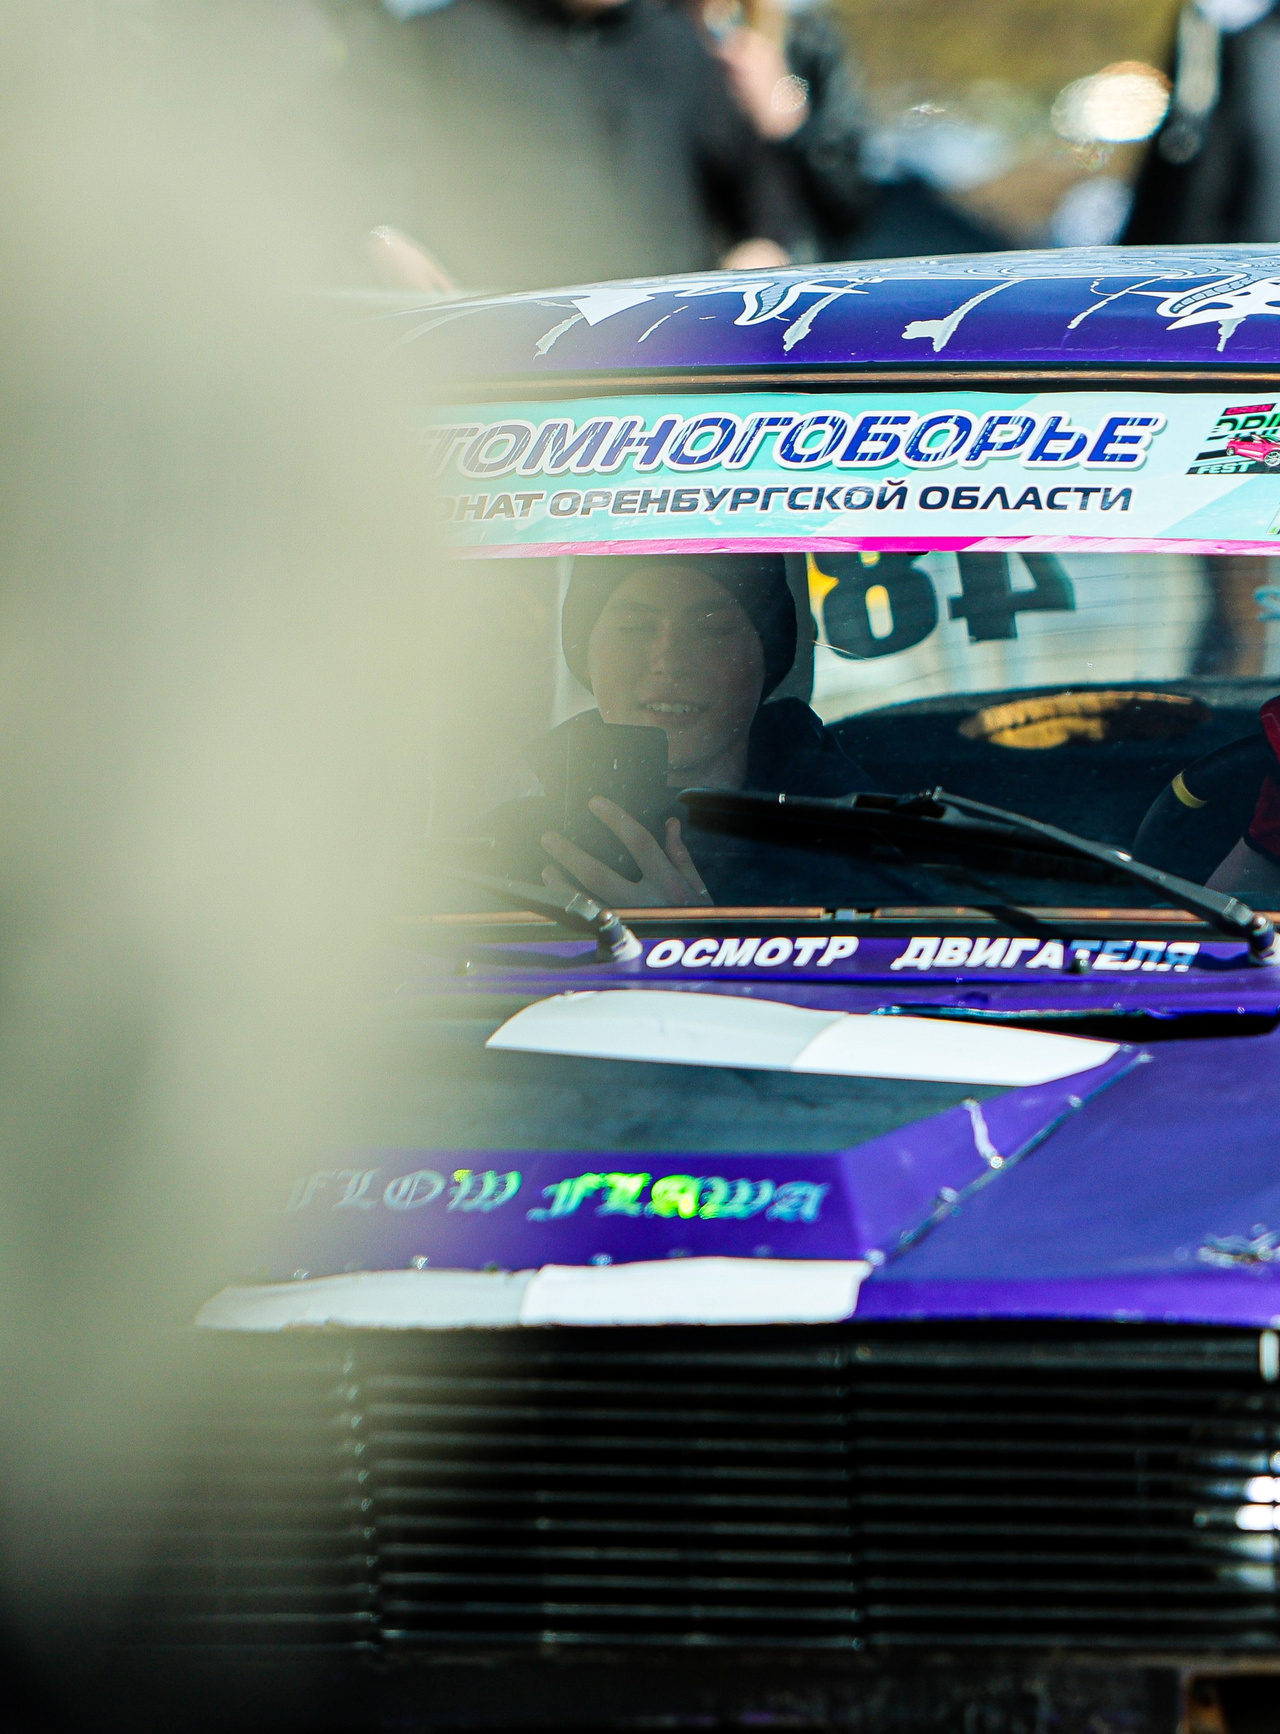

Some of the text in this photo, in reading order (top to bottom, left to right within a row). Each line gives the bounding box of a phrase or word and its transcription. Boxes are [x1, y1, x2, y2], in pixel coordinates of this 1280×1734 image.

[1196, 461, 1257, 475] FEST
[549, 479, 910, 515] ОРЕНБУРГСКОЙ
[917, 485, 1132, 513] ОБЛАСТИ
[646, 936, 1201, 973] ОСМОТР ДВИГАТЕЛЯ
